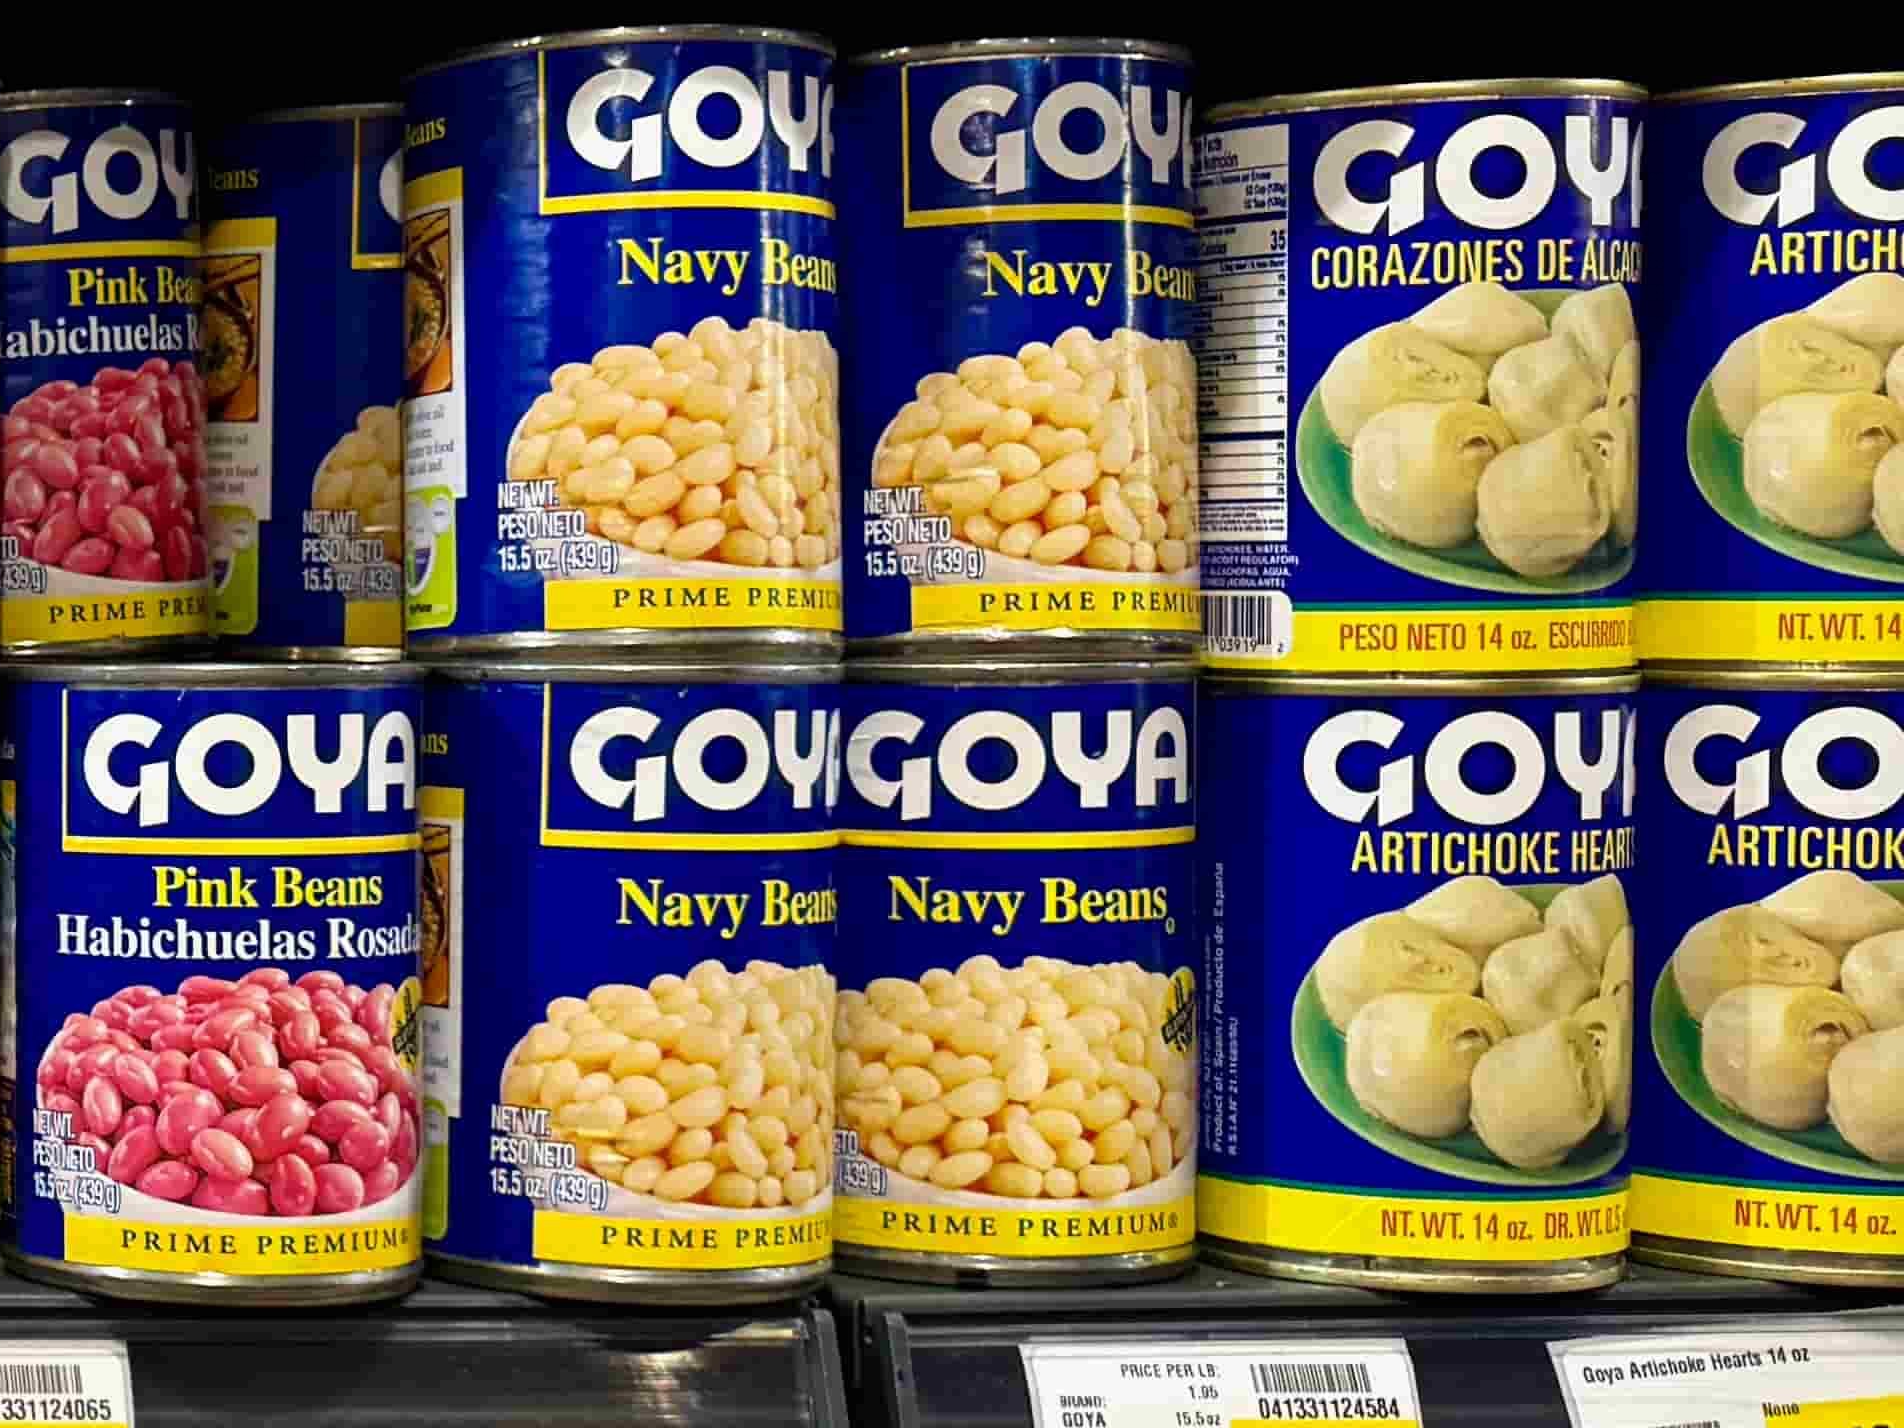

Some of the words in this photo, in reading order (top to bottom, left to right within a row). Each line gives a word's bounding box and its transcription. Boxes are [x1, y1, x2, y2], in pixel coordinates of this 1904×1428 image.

[617, 237, 752, 297] Navy
[1310, 240, 1526, 289] CORAZONES
[1537, 240, 1573, 283] DE
[1339, 624, 1399, 652] PESO
[1406, 622, 1469, 652] NETO
[1475, 621, 1505, 651] 14
[1511, 627, 1538, 652] oz.
[1350, 829, 1562, 874] ARTICHOKE
[152, 867, 260, 910] Pink
[272, 867, 385, 909] Beans
[888, 876, 1027, 937] Navy
[1040, 876, 1167, 923] Beans
[1583, 1365, 1624, 1385] Goya
[1630, 1356, 1705, 1380] Artichoke
[1711, 1352, 1763, 1371] Hearts
[1768, 1348, 1787, 1364] 14
[1791, 1348, 1810, 1363] oz
[1259, 1398, 1400, 1419] 041331124584
